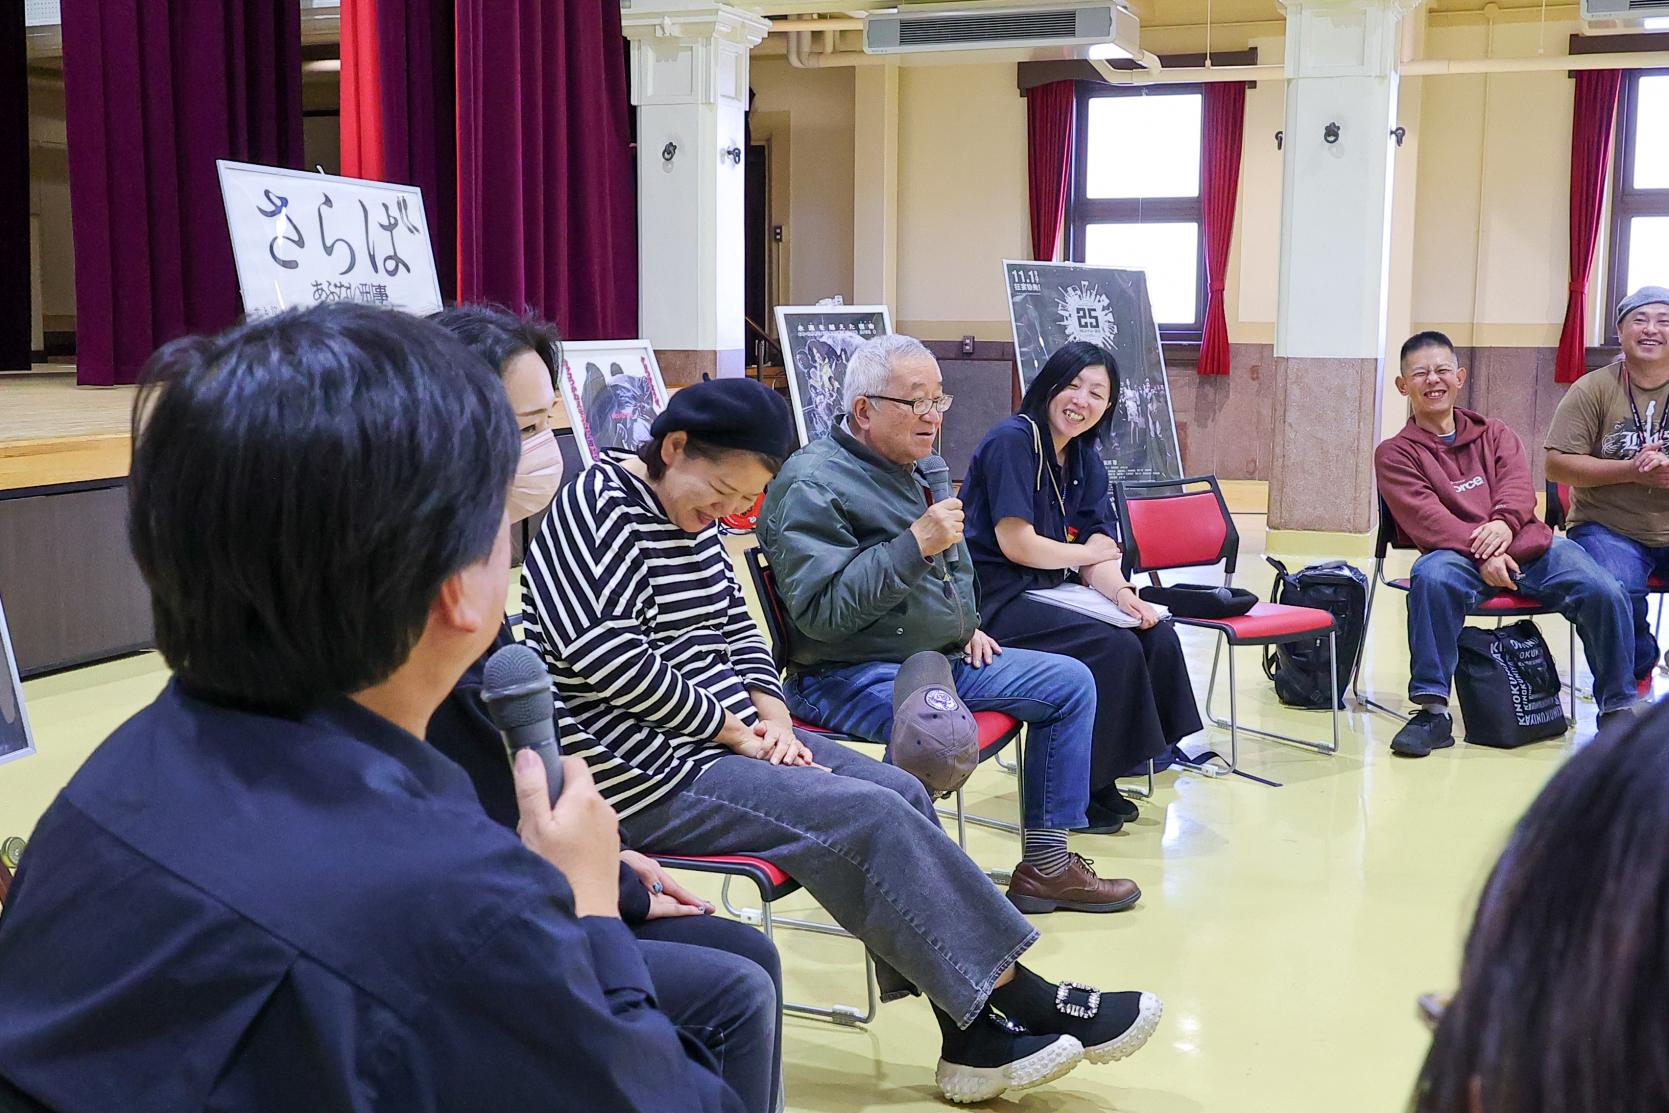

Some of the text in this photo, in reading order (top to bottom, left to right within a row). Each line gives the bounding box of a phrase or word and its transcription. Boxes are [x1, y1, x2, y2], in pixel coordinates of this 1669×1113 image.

[256, 189, 421, 277] さらば
[1076, 307, 1100, 329] 25
